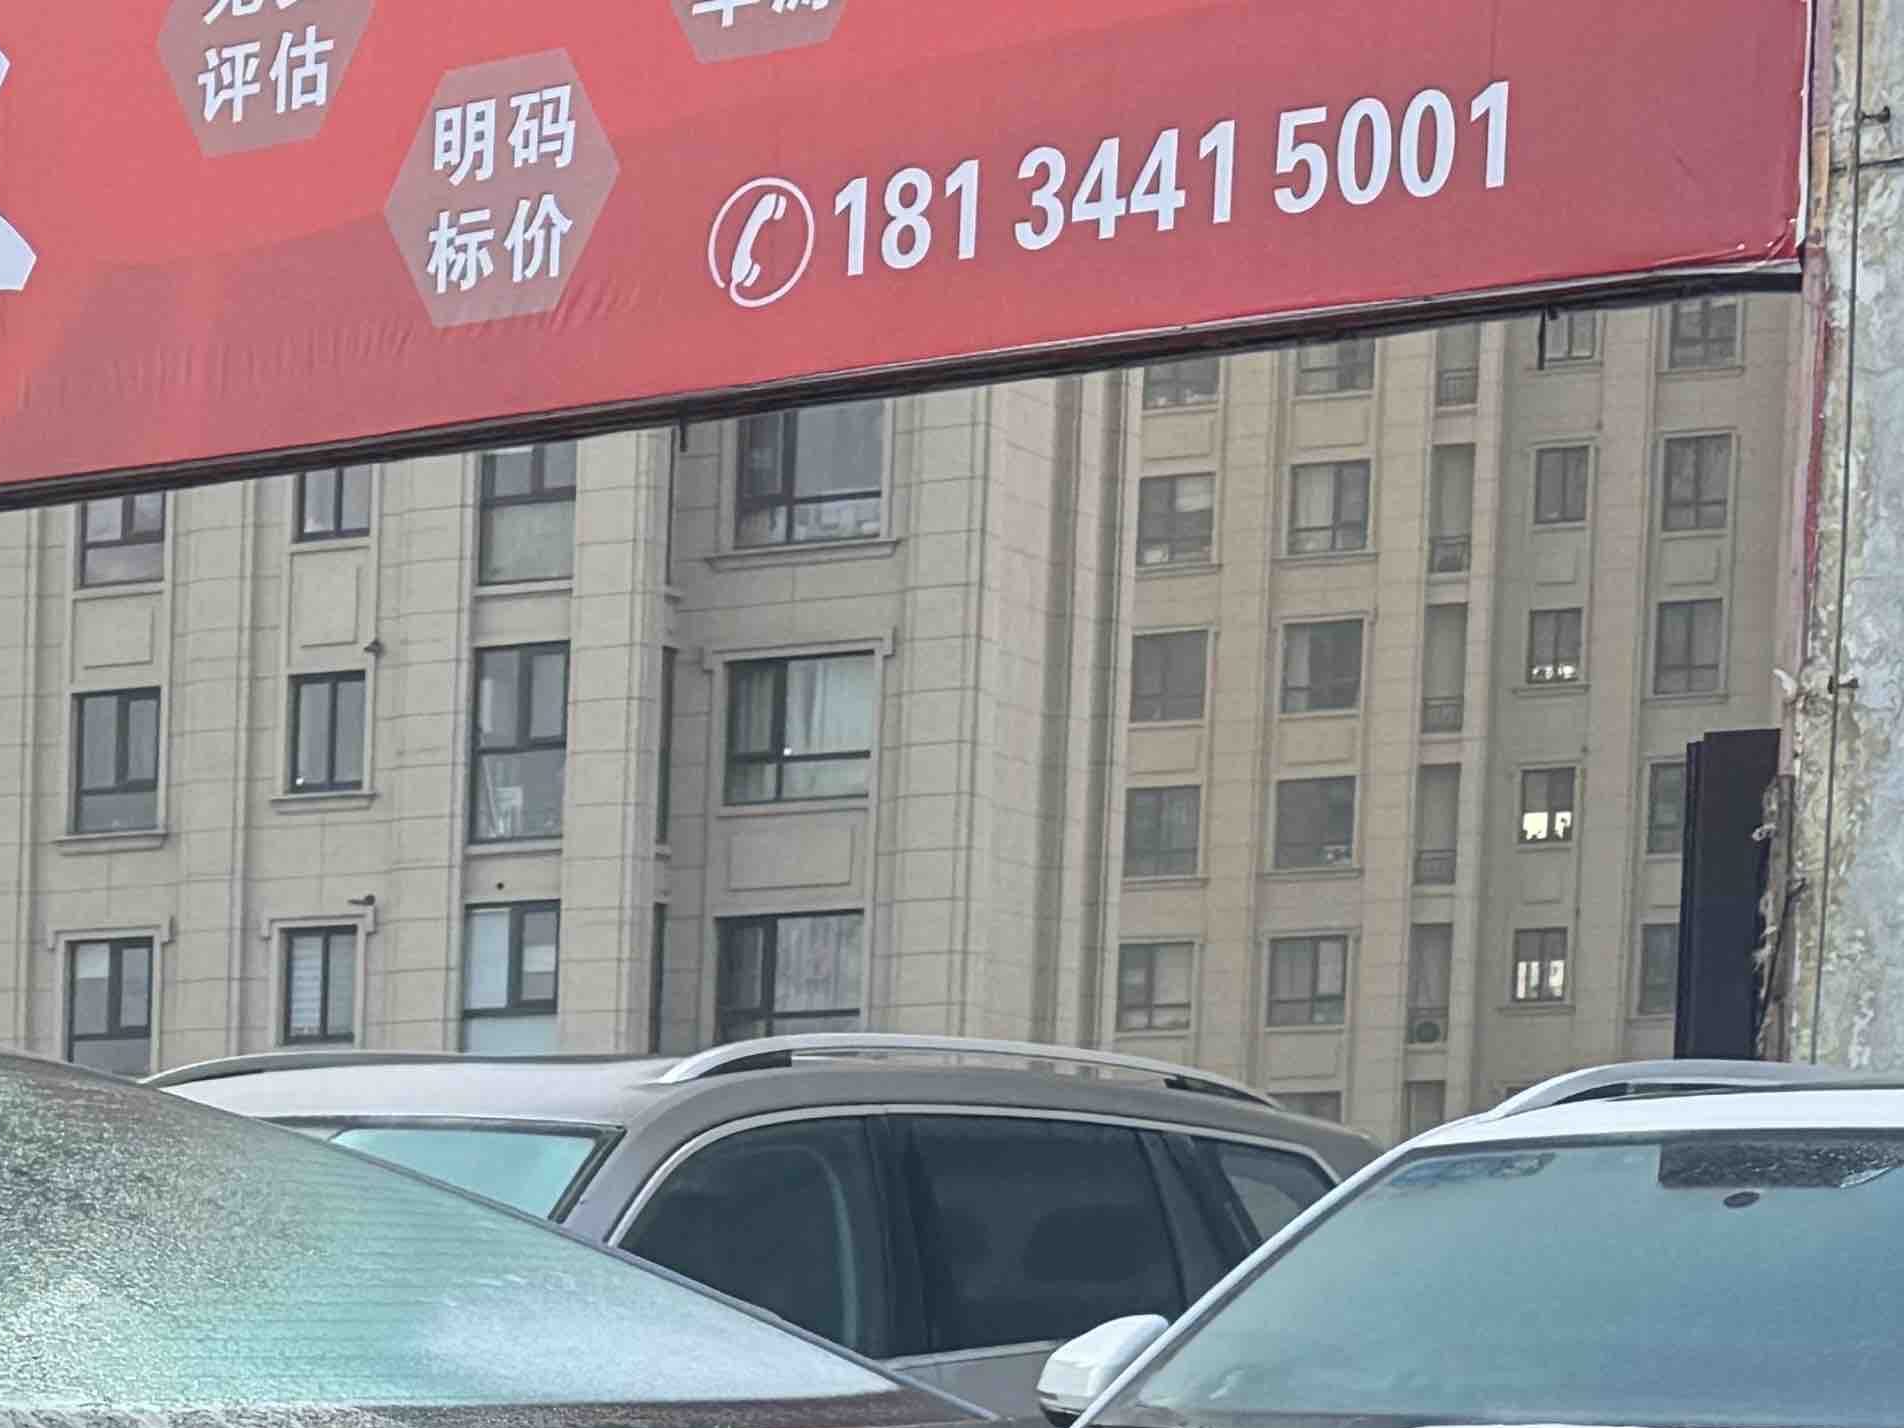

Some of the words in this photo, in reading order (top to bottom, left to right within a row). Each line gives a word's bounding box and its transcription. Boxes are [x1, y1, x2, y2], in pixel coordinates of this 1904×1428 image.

[196, 25, 334, 123] 评估
[432, 84, 577, 187] 明码
[833, 159, 980, 277] 181
[1013, 119, 1236, 251] 3441
[1272, 81, 1511, 214] 5001
[426, 193, 574, 294] 标价
